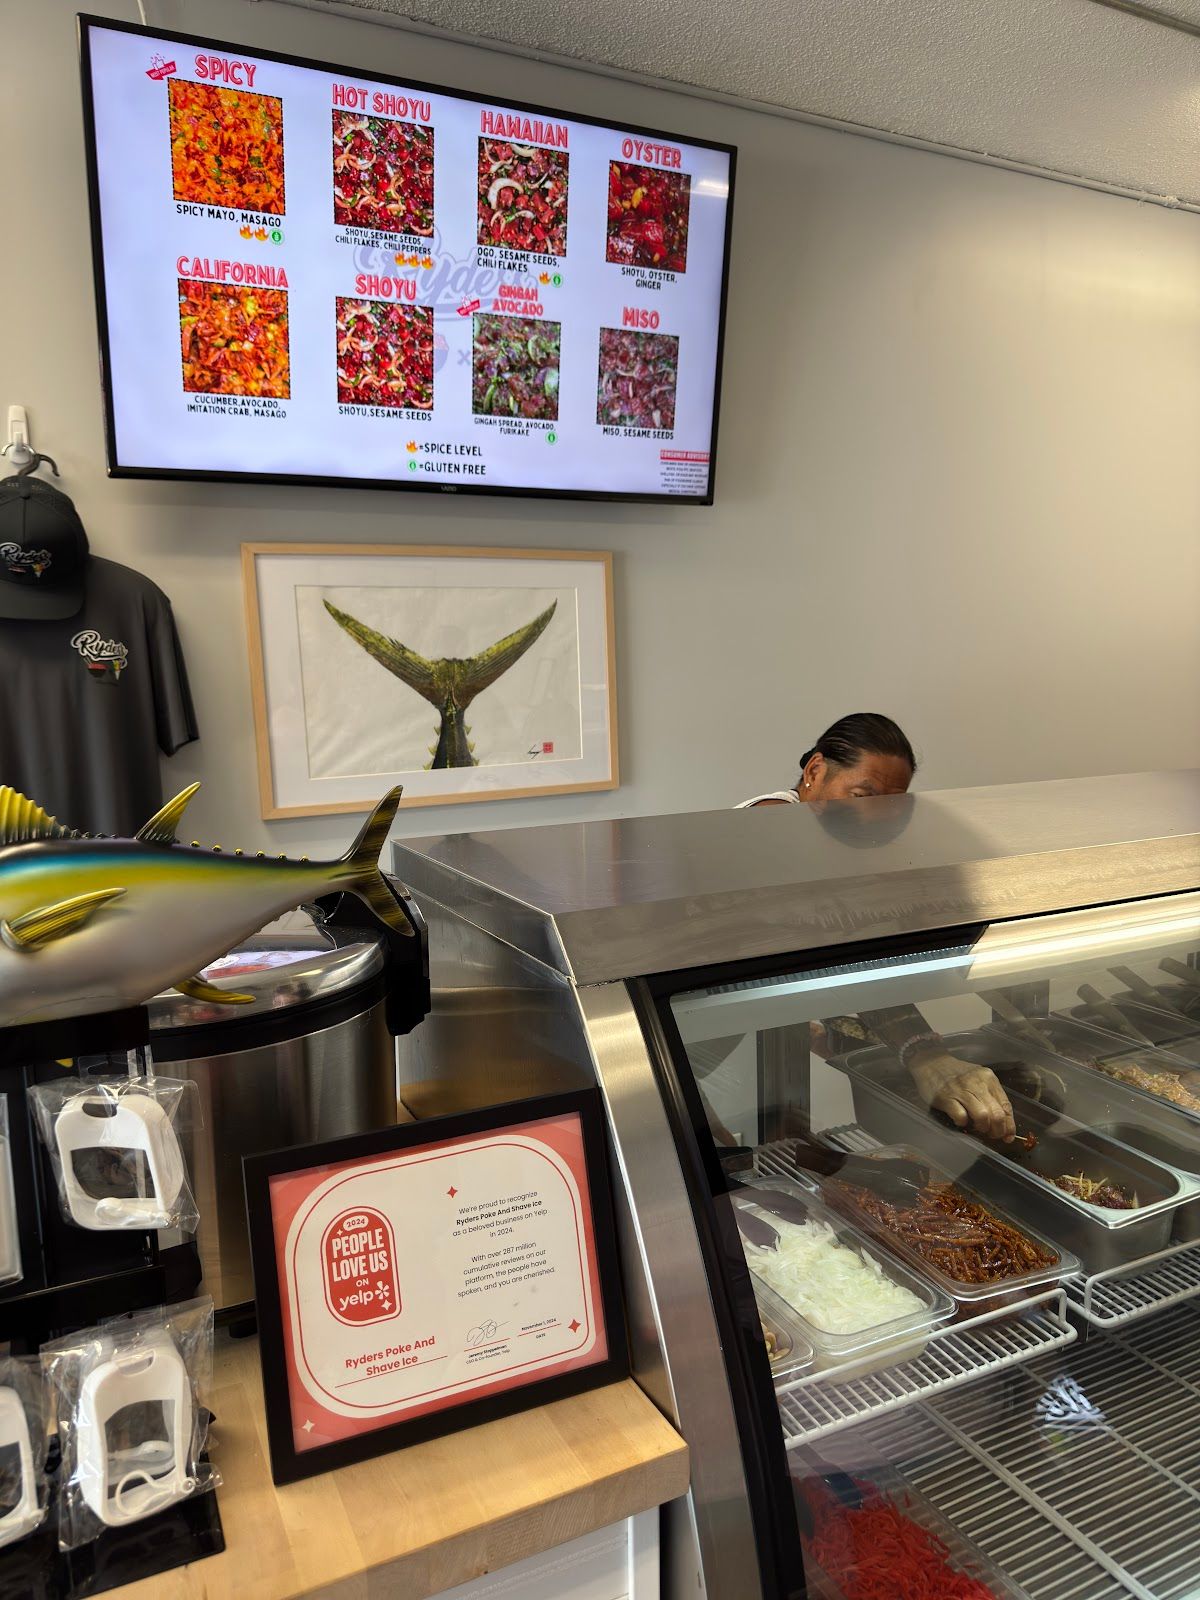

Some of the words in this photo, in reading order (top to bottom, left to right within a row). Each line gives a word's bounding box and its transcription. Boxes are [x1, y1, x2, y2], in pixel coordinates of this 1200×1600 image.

[194, 54, 257, 87] SPICY
[333, 83, 368, 110] HOT
[372, 92, 431, 122] SHOYU
[480, 110, 568, 148] HAWAIIAN
[621, 138, 682, 168] OYSTER
[176, 204, 204, 217] SPICY
[207, 208, 239, 223] MAYO,
[241, 213, 281, 227] MASAGO
[335, 235, 353, 244] CHILI
[383, 241, 401, 251] CHILI
[401, 244, 432, 255] PEPPERS
[370, 231, 398, 242] SESAME
[477, 247, 497, 259] OGO,
[499, 250, 531, 262] SESAME
[532, 255, 560, 268] SEEDS,
[477, 257, 497, 269] CHILI
[498, 260, 528, 273] FLAKES
[176, 255, 289, 288] CALIFORNIA
[621, 266, 647, 279] SHOYU,
[355, 273, 417, 302] SHOYU
[635, 279, 661, 290] GINGER
[492, 298, 544, 317] AVOCADO
[622, 306, 660, 330] MISO
[187, 404, 226, 415] IMITATION
[254, 409, 287, 419] MASAGO
[369, 409, 404, 419] SESAME
[406, 412, 432, 421] SEEDS
[500, 427, 530, 436] FURIKAKE
[623, 428, 651, 438] SESAME
[652, 430, 674, 440] SEEDS
[454, 445, 483, 456] LEVEL
[462, 464, 486, 475] FREE
[456, 1215, 479, 1226] Ryders
[480, 1211, 497, 1220] Poke
[497, 1207, 511, 1216] And
[511, 1203, 531, 1213] Shave
[532, 1199, 542, 1207] Ice
[458, 1205, 477, 1215] We're
[478, 1200, 498, 1211] proud
[506, 1191, 538, 1203] recognize
[346, 1217, 365, 1228] 2024
[468, 1222, 495, 1233] beloved
[495, 1216, 523, 1227] business
[534, 1209, 548, 1219] Yelp
[331, 1227, 385, 1259] PEOPLE
[489, 1230, 496, 1238] in
[497, 1227, 515, 1237] 2024.
[463, 1262, 500, 1276] cumulative
[500, 1256, 525, 1267] reviews
[525, 1252, 535, 1260] on
[535, 1249, 547, 1257] our
[471, 1254, 486, 1263] With
[487, 1250, 502, 1259] over
[502, 1247, 514, 1255] 287
[515, 1241, 536, 1252] million
[331, 1254, 369, 1282] LOVE
[369, 1250, 389, 1273] US
[464, 1273, 495, 1287] platform,
[495, 1269, 507, 1278] the
[507, 1263, 530, 1276] people
[530, 1259, 547, 1268] have
[355, 1278, 369, 1287] ON
[457, 1284, 483, 1298] spoken,
[483, 1282, 498, 1291] and
[498, 1279, 511, 1289] you
[511, 1276, 523, 1284] are
[339, 1289, 374, 1311] yelp
[345, 1351, 383, 1369] Ryders
[385, 1342, 412, 1358] Poke
[414, 1335, 436, 1349] And
[366, 1360, 400, 1376] Shave
[402, 1355, 418, 1367] Ice
